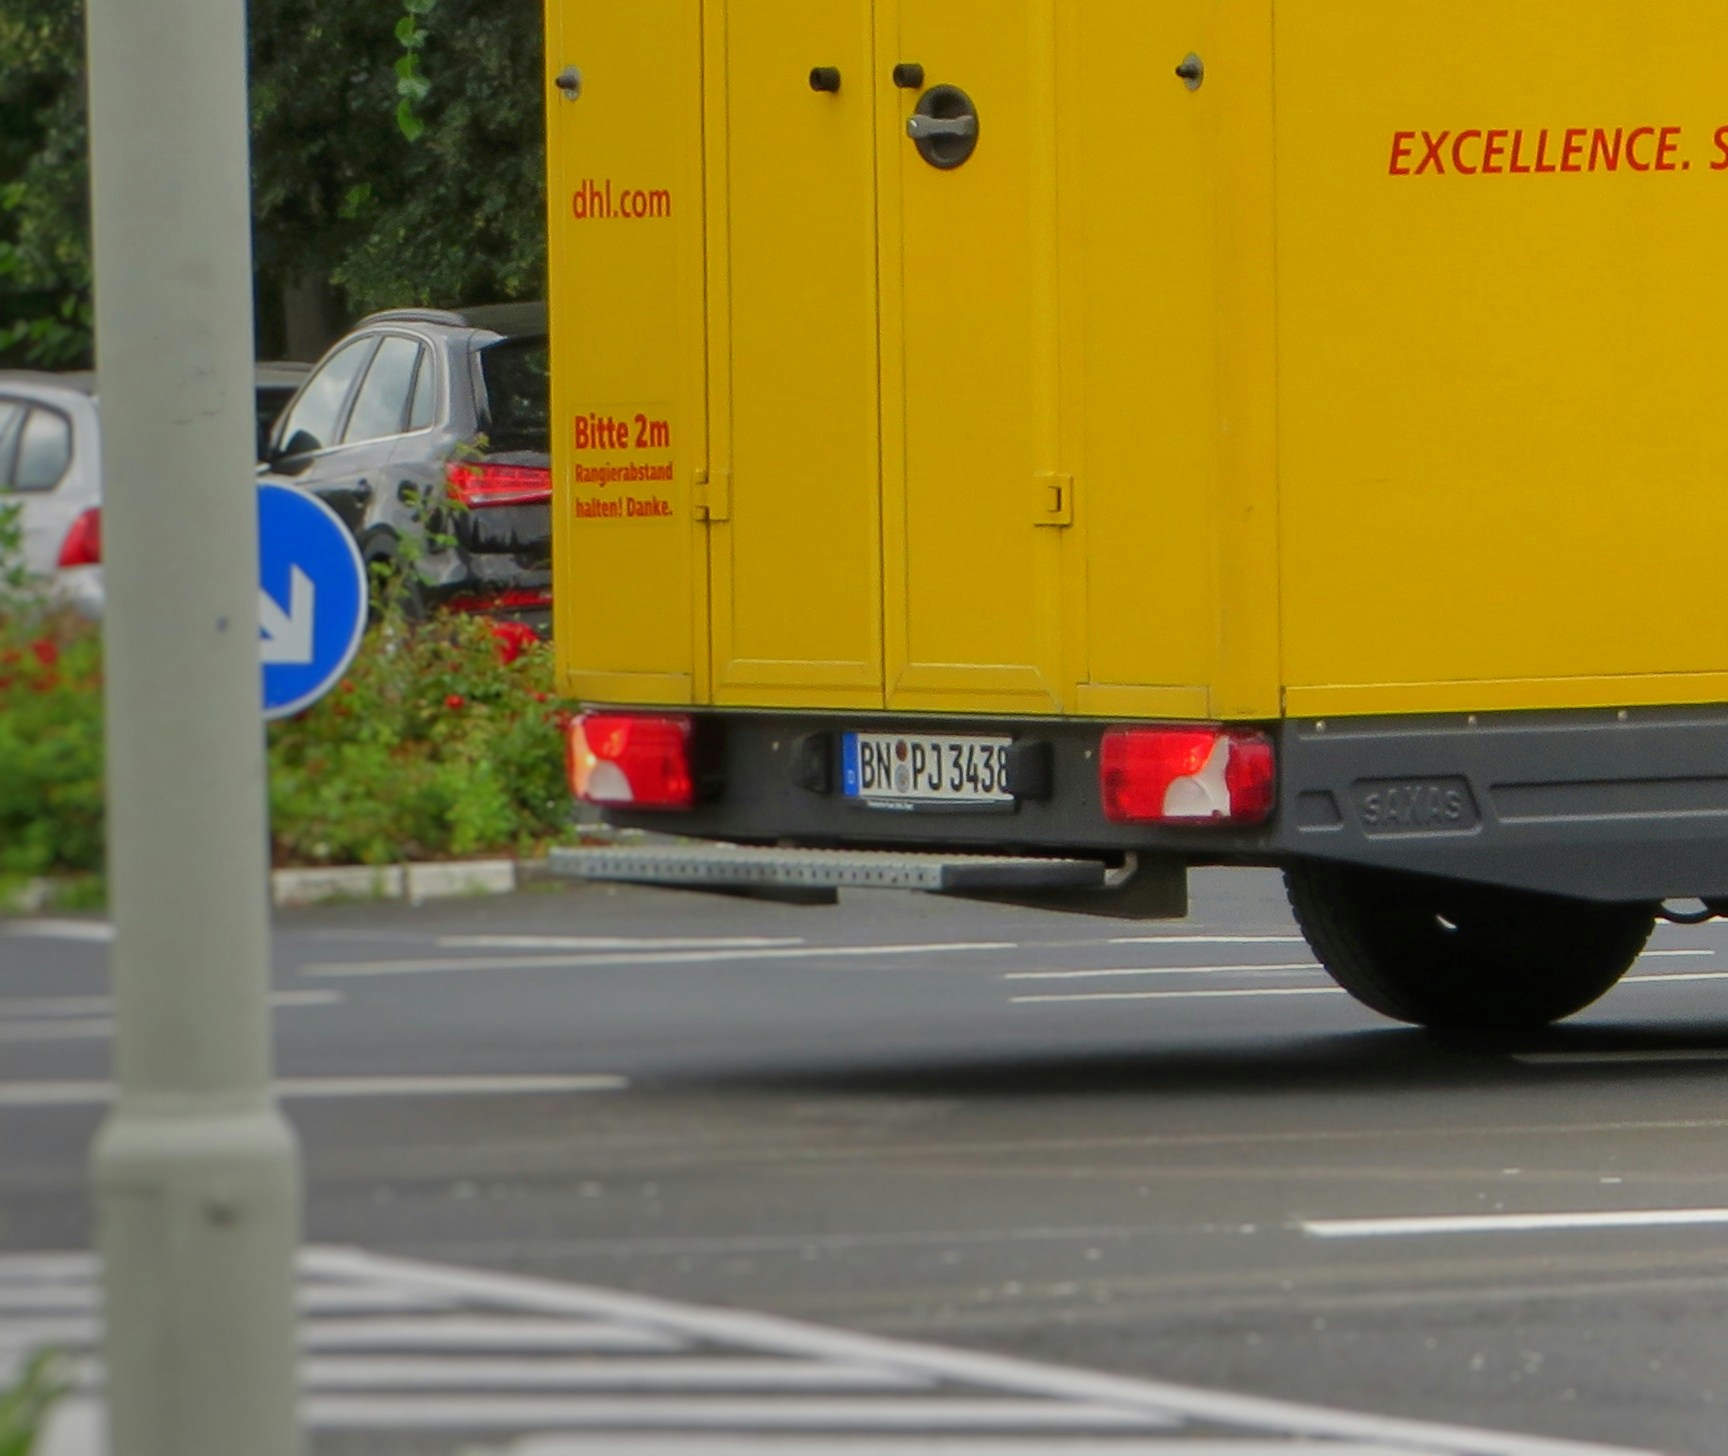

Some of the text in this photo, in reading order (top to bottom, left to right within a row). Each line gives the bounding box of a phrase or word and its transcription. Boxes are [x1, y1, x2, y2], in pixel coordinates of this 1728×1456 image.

[1387, 127, 1691, 176] EXCELLENCE.
[572, 178, 671, 219] dhl.com
[574, 411, 671, 450] Bitte 2m
[626, 495, 673, 518] Danke.
[860, 740, 1009, 795] BN PJ 3438
